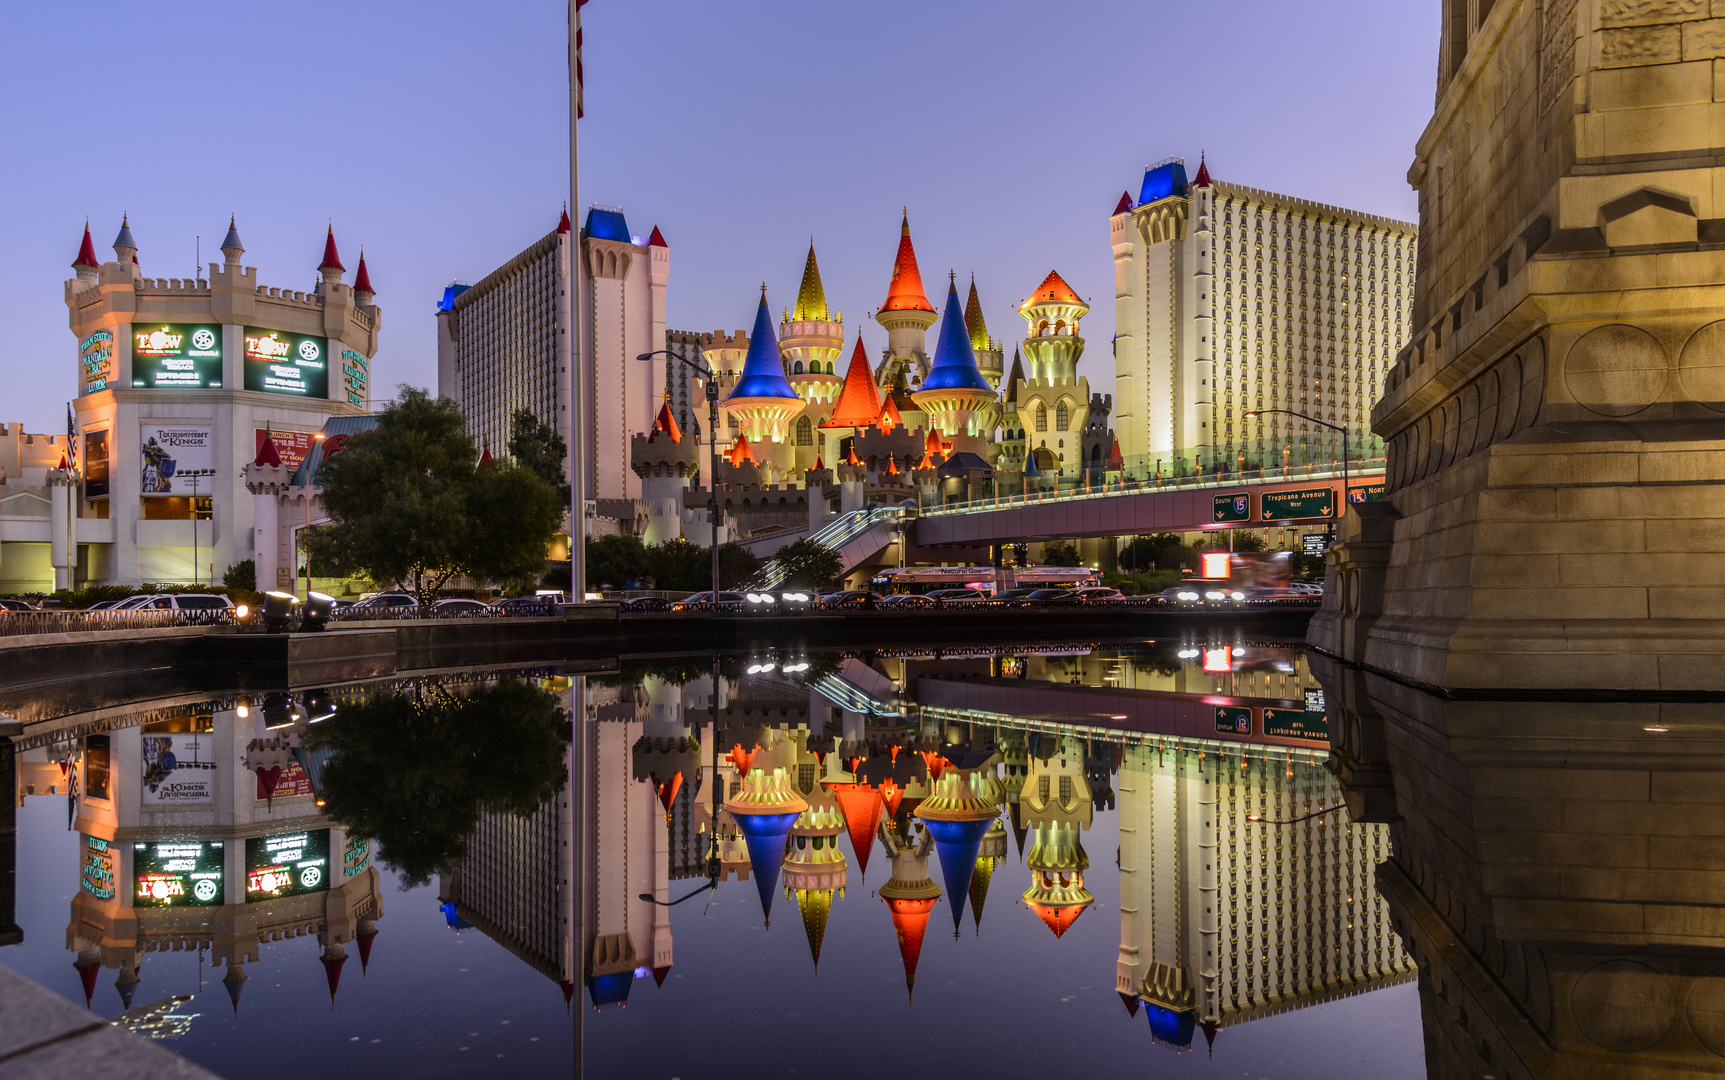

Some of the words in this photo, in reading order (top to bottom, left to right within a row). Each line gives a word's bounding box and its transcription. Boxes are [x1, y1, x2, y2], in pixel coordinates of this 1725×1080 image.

[82, 347, 112, 366] MANDALAY
[92, 362, 102, 374] BAY
[88, 378, 106, 393] LUXOR
[157, 430, 208, 439] TOURNAMENT
[169, 438, 204, 446] KINGS
[1267, 494, 1298, 502] Tropicana
[1237, 501, 1244, 510] 15
